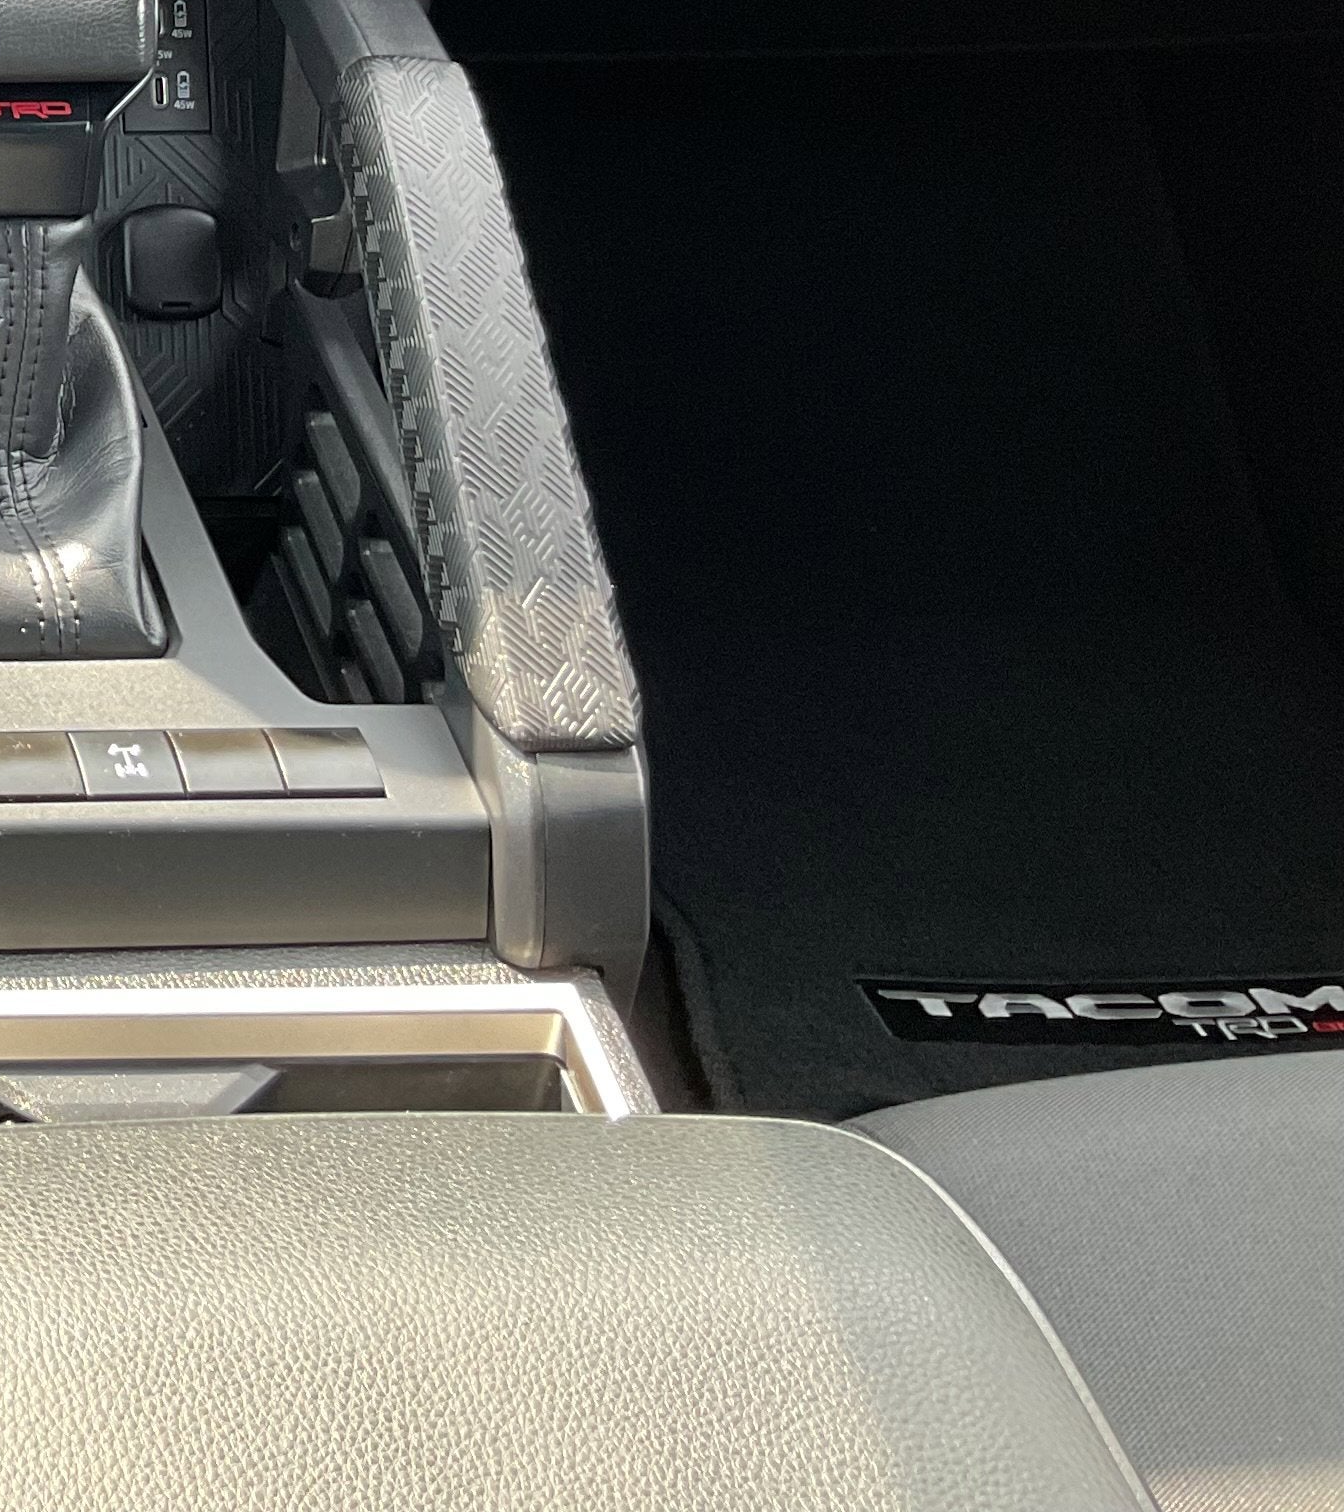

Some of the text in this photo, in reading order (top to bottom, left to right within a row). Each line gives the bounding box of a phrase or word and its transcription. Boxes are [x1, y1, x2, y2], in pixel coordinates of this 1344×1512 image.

[170, 28, 193, 39] 45W
[173, 99, 195, 110] 45W
[1172, 1015, 1308, 1041] TRD
